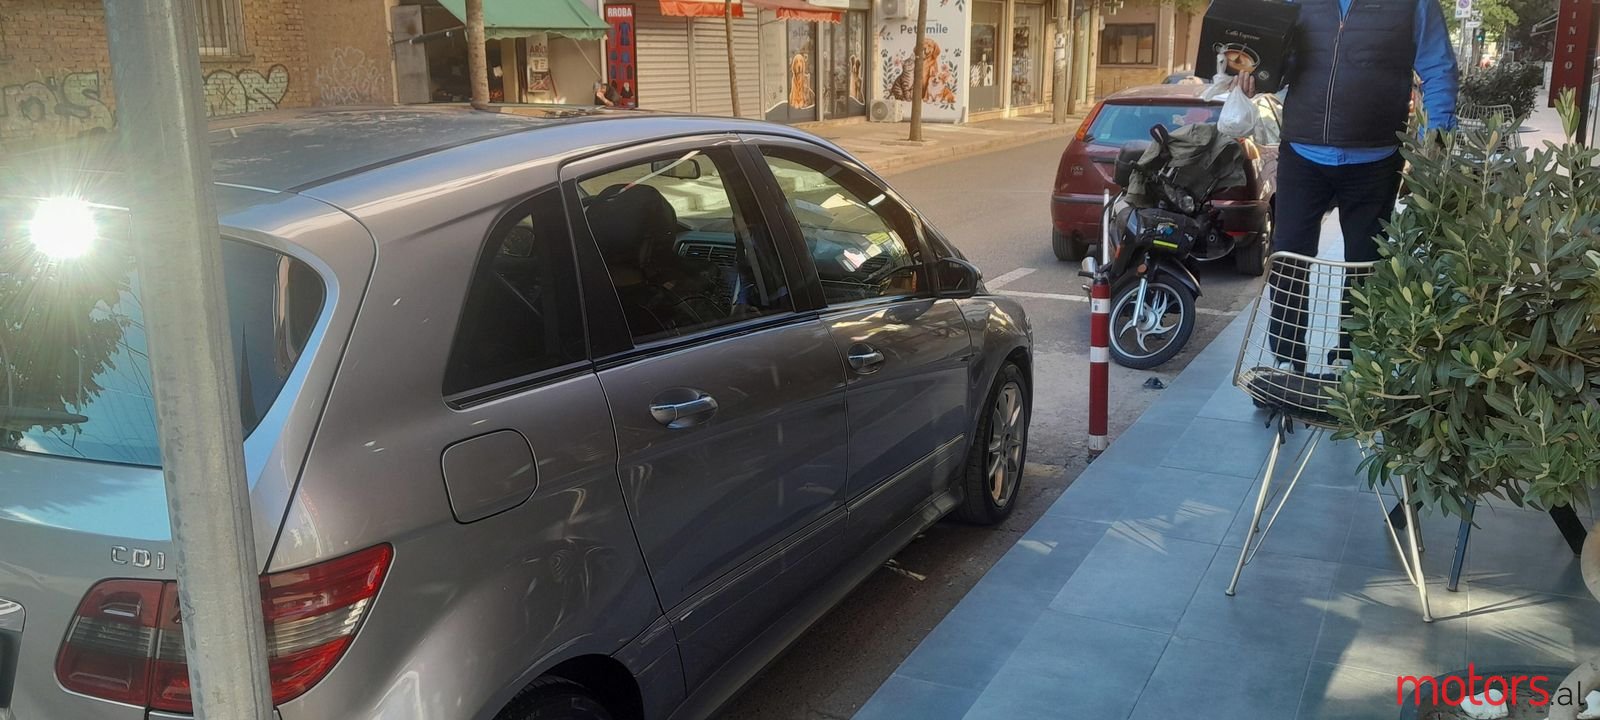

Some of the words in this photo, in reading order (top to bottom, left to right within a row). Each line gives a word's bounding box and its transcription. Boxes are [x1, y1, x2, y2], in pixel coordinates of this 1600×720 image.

[607, 7, 632, 17] RROBA
[900, 23, 948, 34] Petmile
[111, 545, 166, 570] CDI
